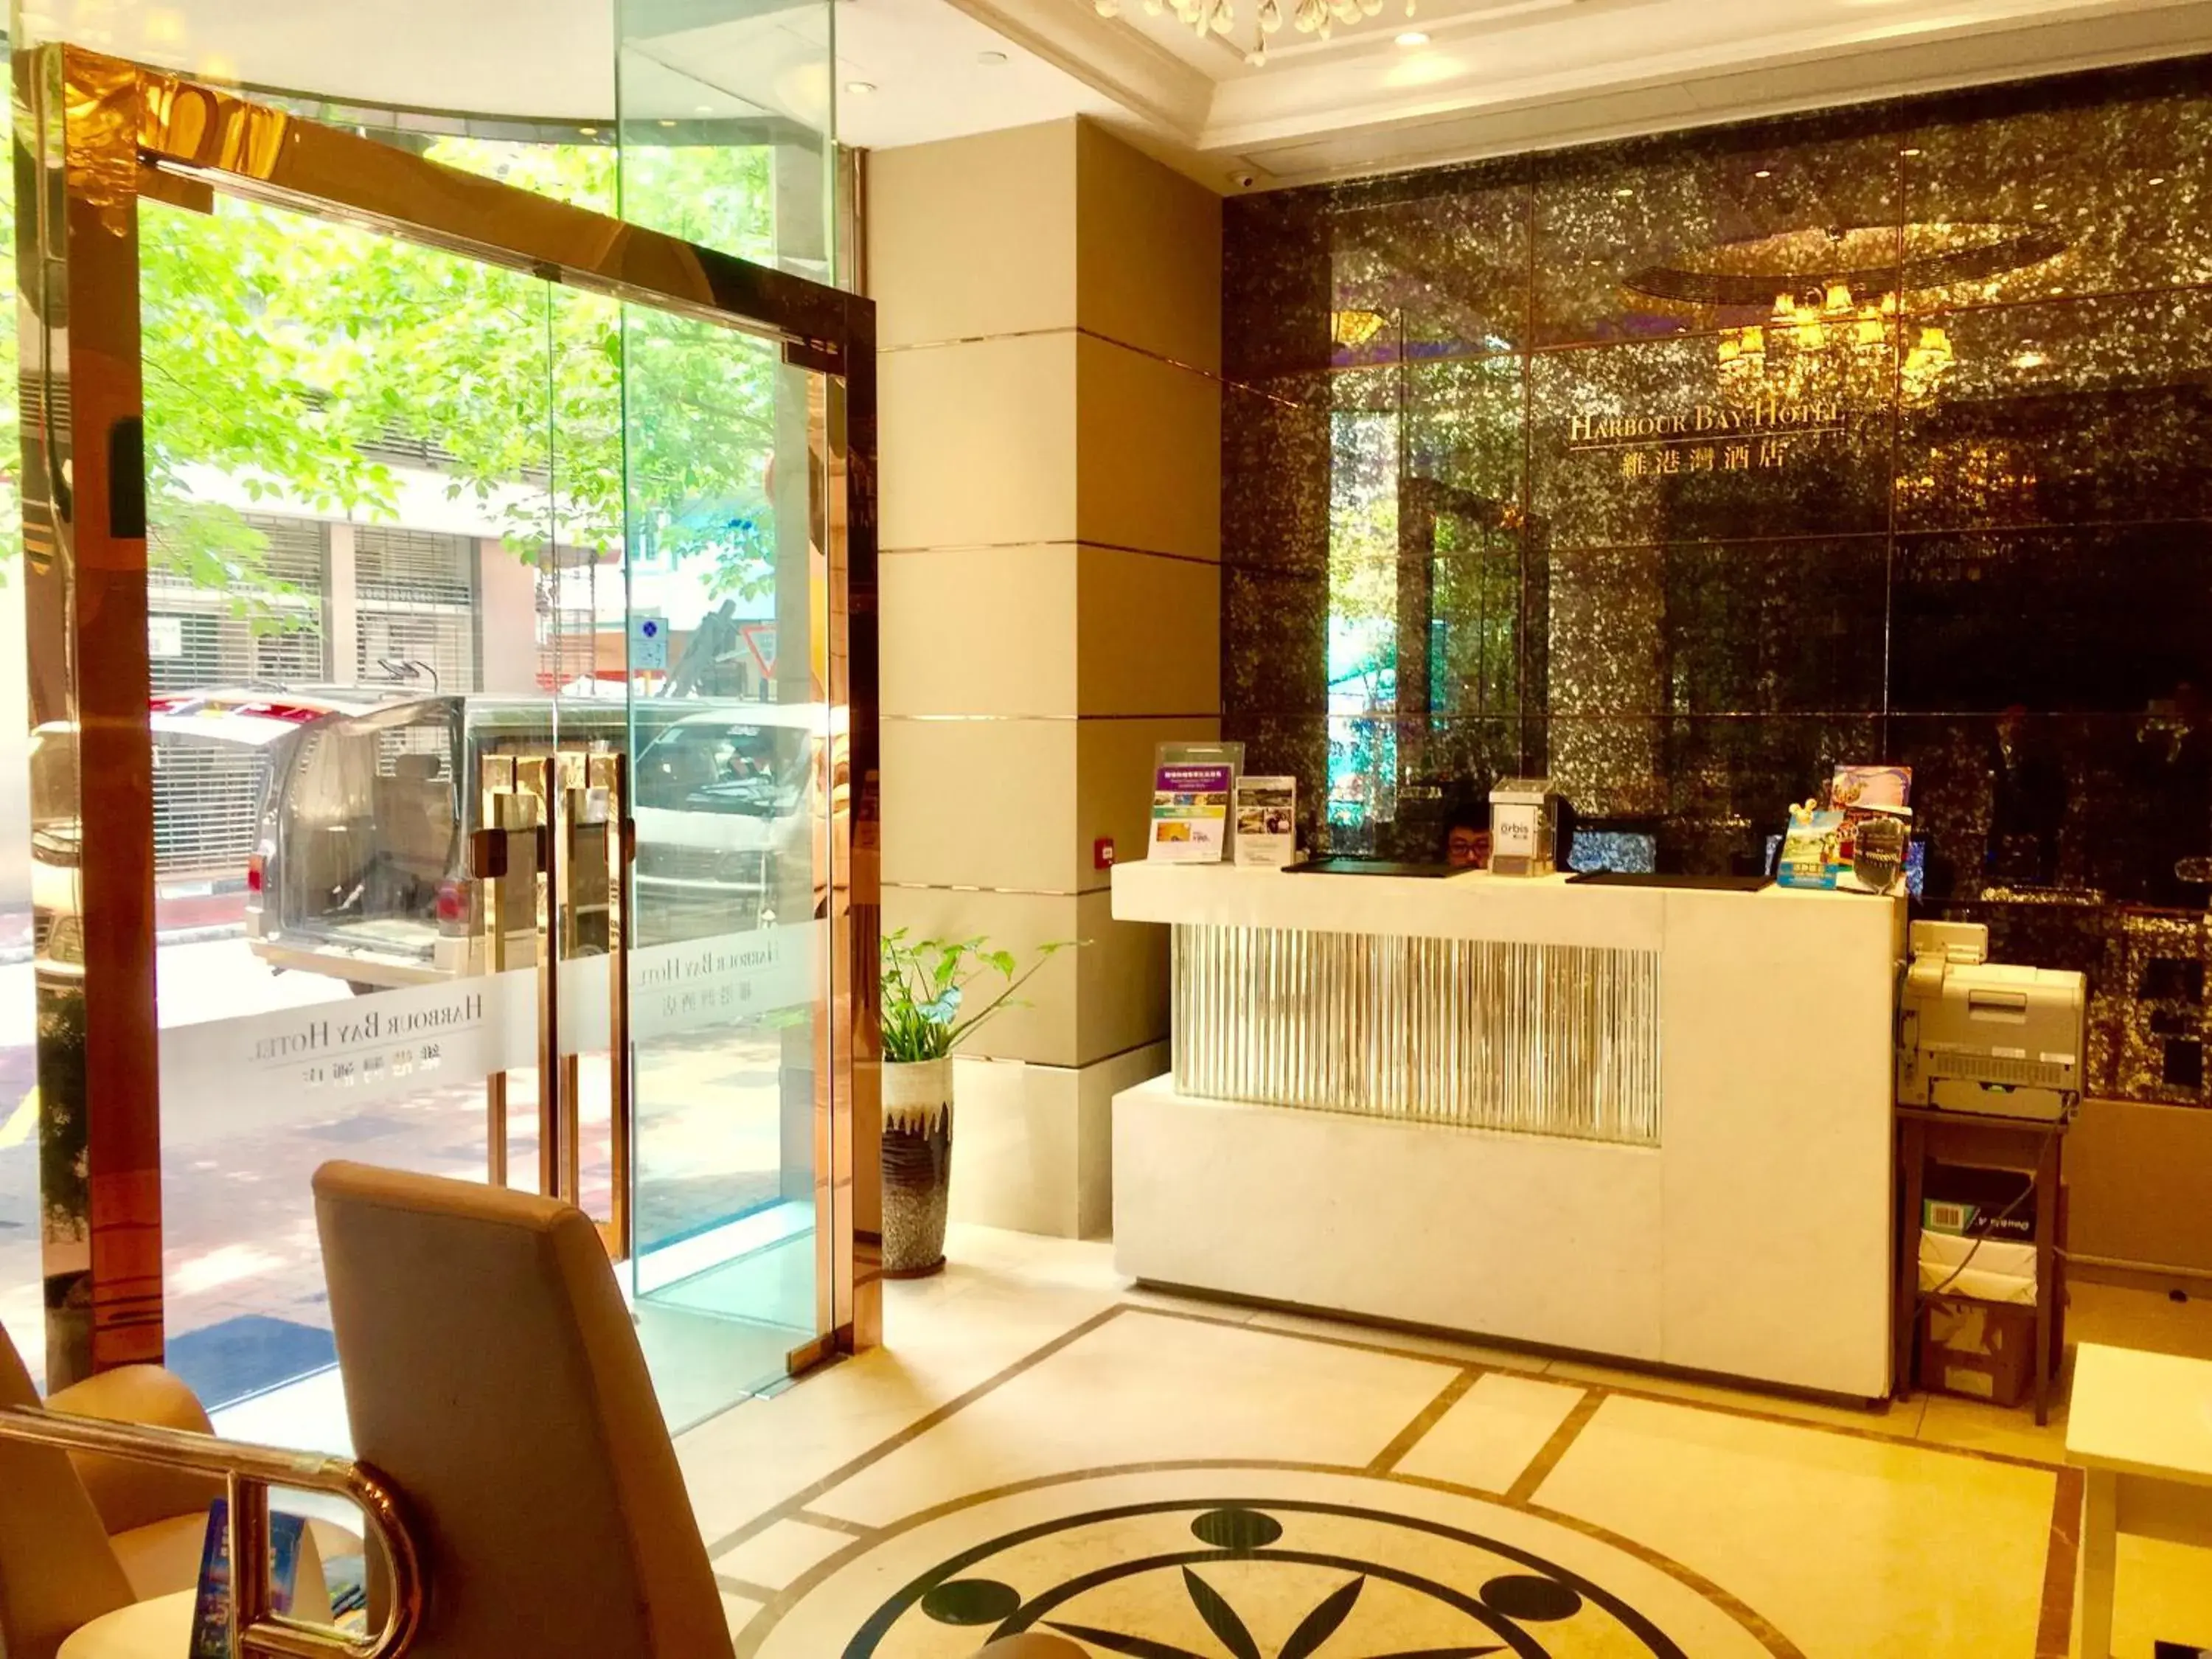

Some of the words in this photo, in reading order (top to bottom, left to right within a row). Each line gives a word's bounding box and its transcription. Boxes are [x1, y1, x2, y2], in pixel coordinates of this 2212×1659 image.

[1570, 414, 1687, 442] HARBOUR
[1695, 404, 1746, 431] BAY
[1753, 399, 1845, 428] HOTEL
[1621, 444, 1787, 478] 維港灣酒店
